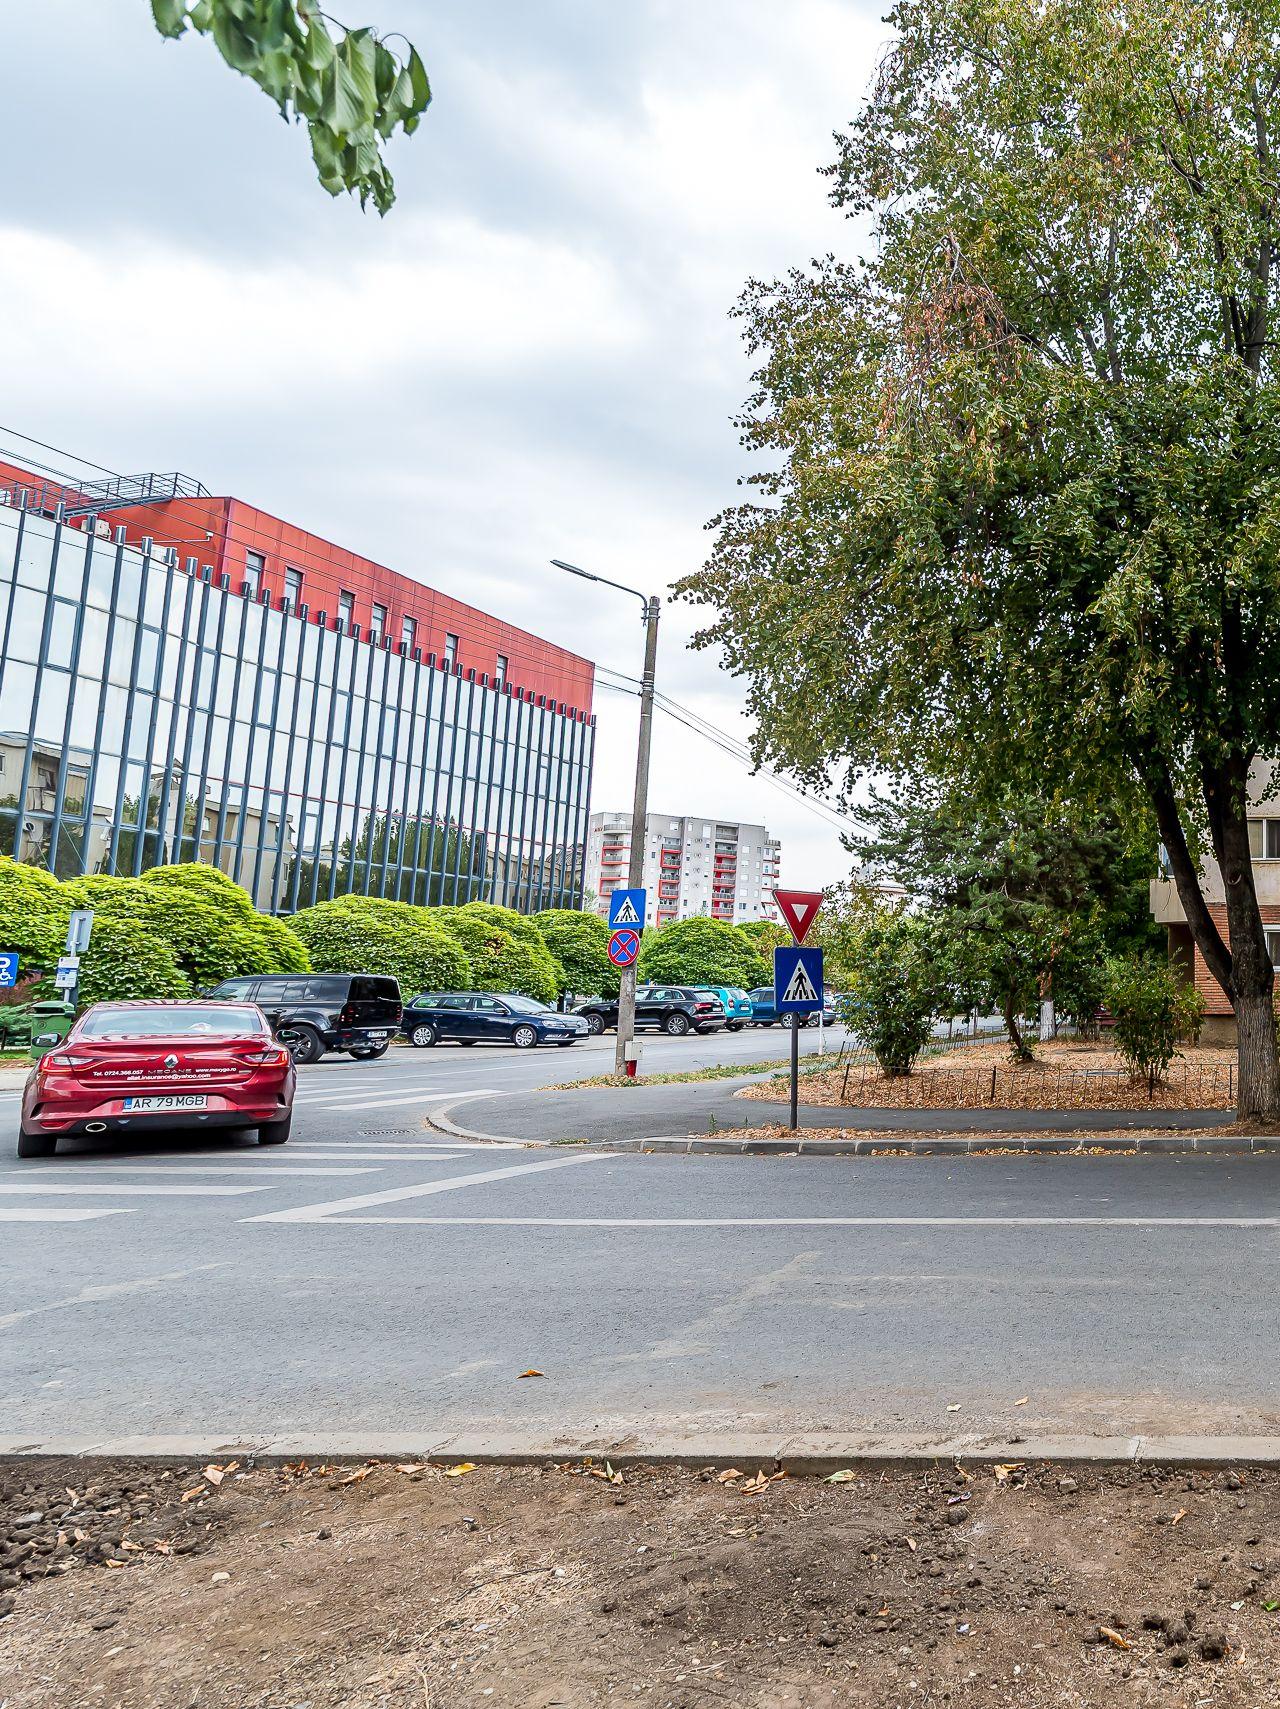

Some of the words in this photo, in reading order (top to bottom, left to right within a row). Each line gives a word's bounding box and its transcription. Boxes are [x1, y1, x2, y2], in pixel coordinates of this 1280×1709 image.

[133, 1098, 152, 1109] AR
[156, 1097, 173, 1107] 79
[176, 1095, 205, 1107] MGB
